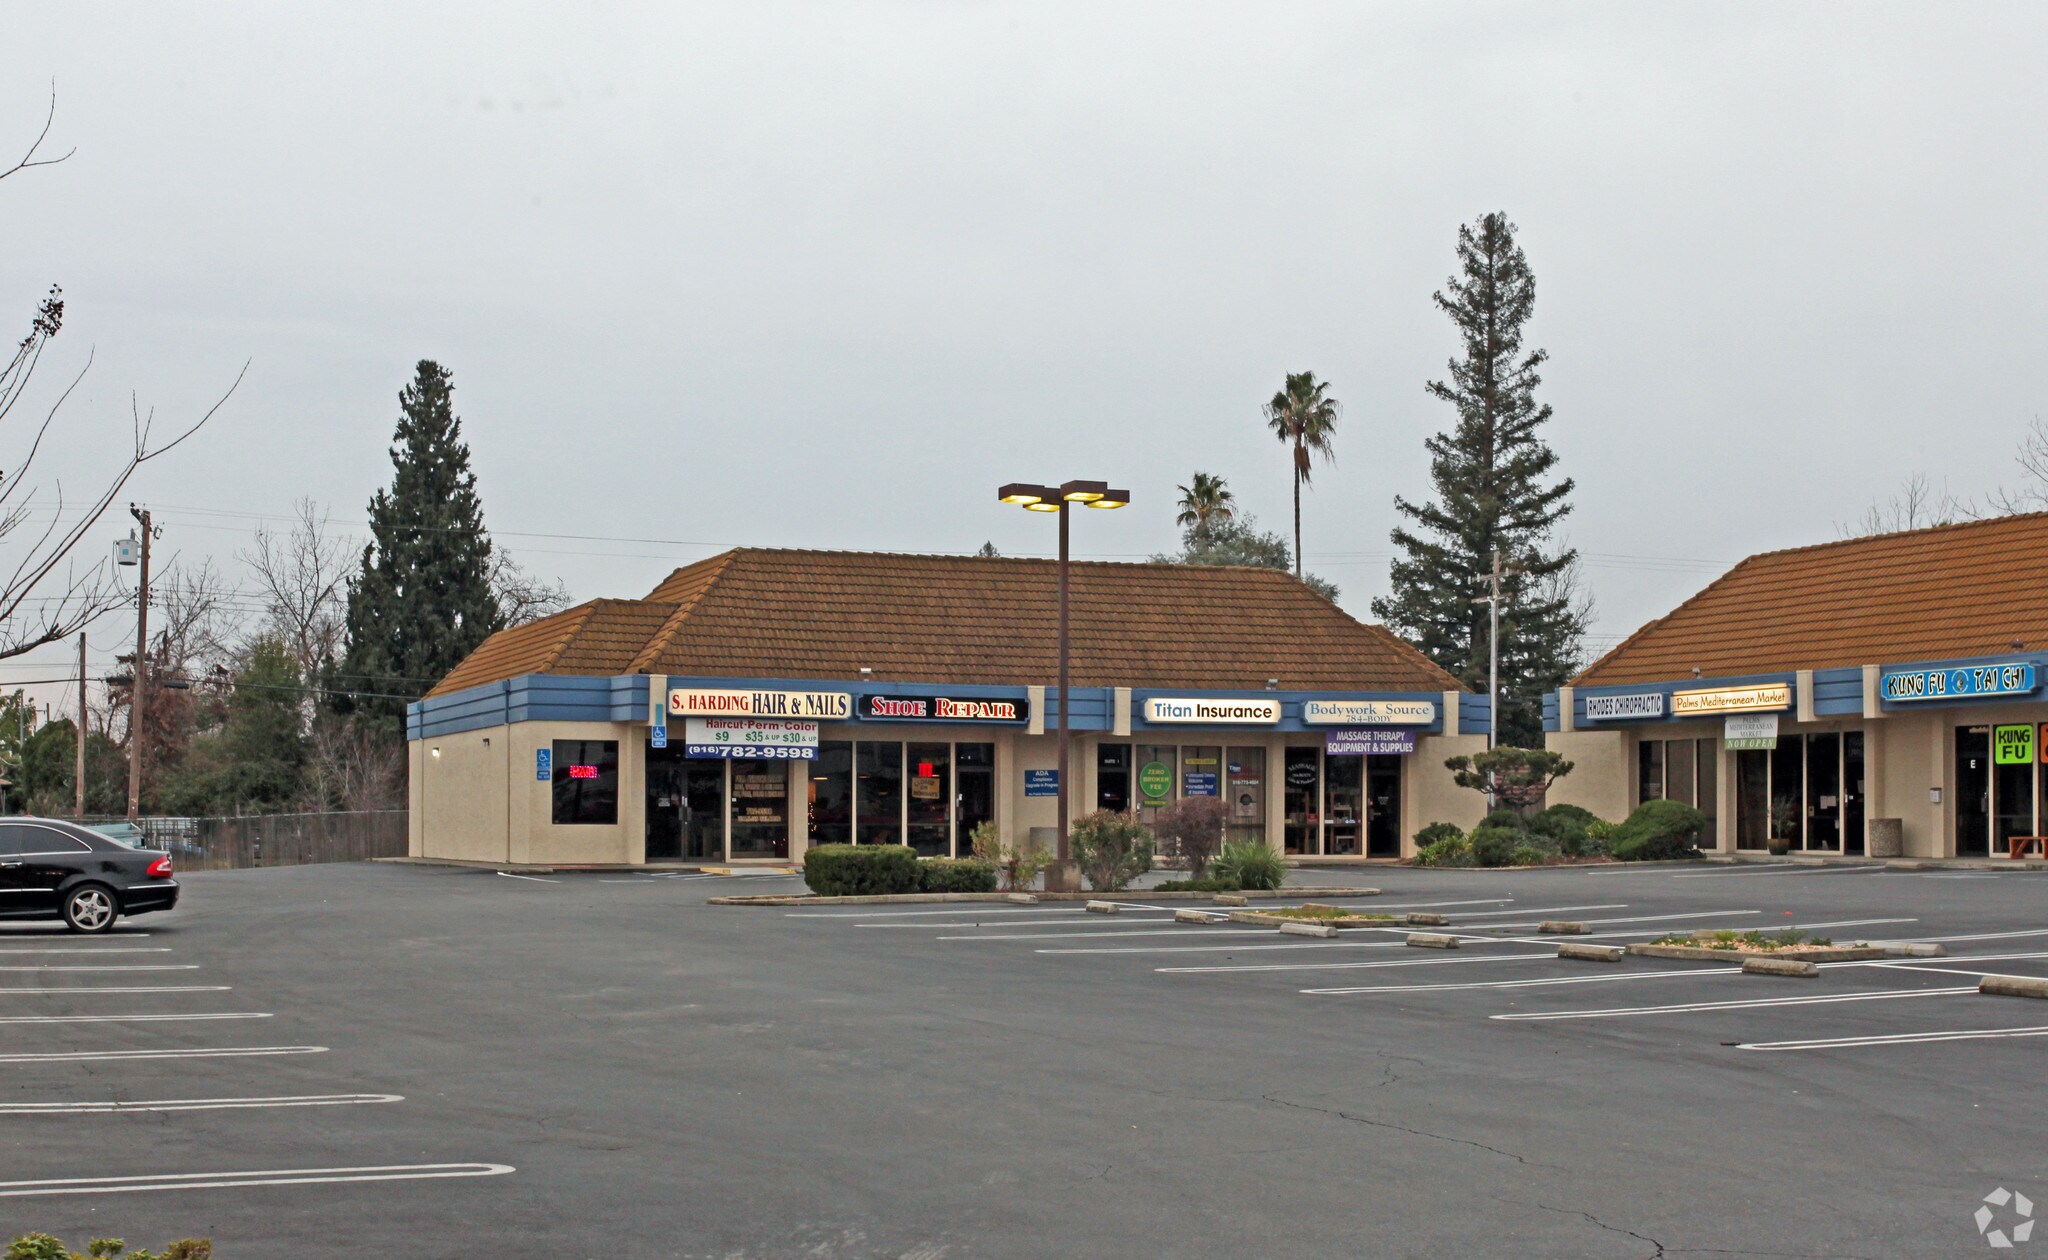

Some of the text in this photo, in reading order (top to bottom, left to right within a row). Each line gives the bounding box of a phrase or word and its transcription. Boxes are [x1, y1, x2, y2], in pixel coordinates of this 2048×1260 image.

[1888, 666, 2025, 696] KUNG FU TAI CHI
[672, 693, 847, 716] S. HARDING HAIR & NAILS
[872, 696, 1016, 719] SHOE REPAIR
[1588, 695, 1661, 716] RHODES CHIROPRACTIC
[1676, 692, 1785, 709] Palms Mediterranean Market
[1154, 703, 1272, 718] Titan Insurance
[1310, 703, 1429, 717] Bodywork Source
[715, 731, 729, 742] $9
[745, 731, 763, 743] $35
[782, 732, 800, 743] $30
[1336, 731, 1406, 741] MASSAGE THERAPY
[1728, 738, 1774, 748] NOW OPEN
[1998, 729, 2030, 744] KUNG
[1328, 742, 1413, 753] EQUIPMENT & SUPPLIES
[2002, 745, 2026, 759] FU
[1970, 759, 1976, 769] E
[572, 767, 595, 777] HAIR
